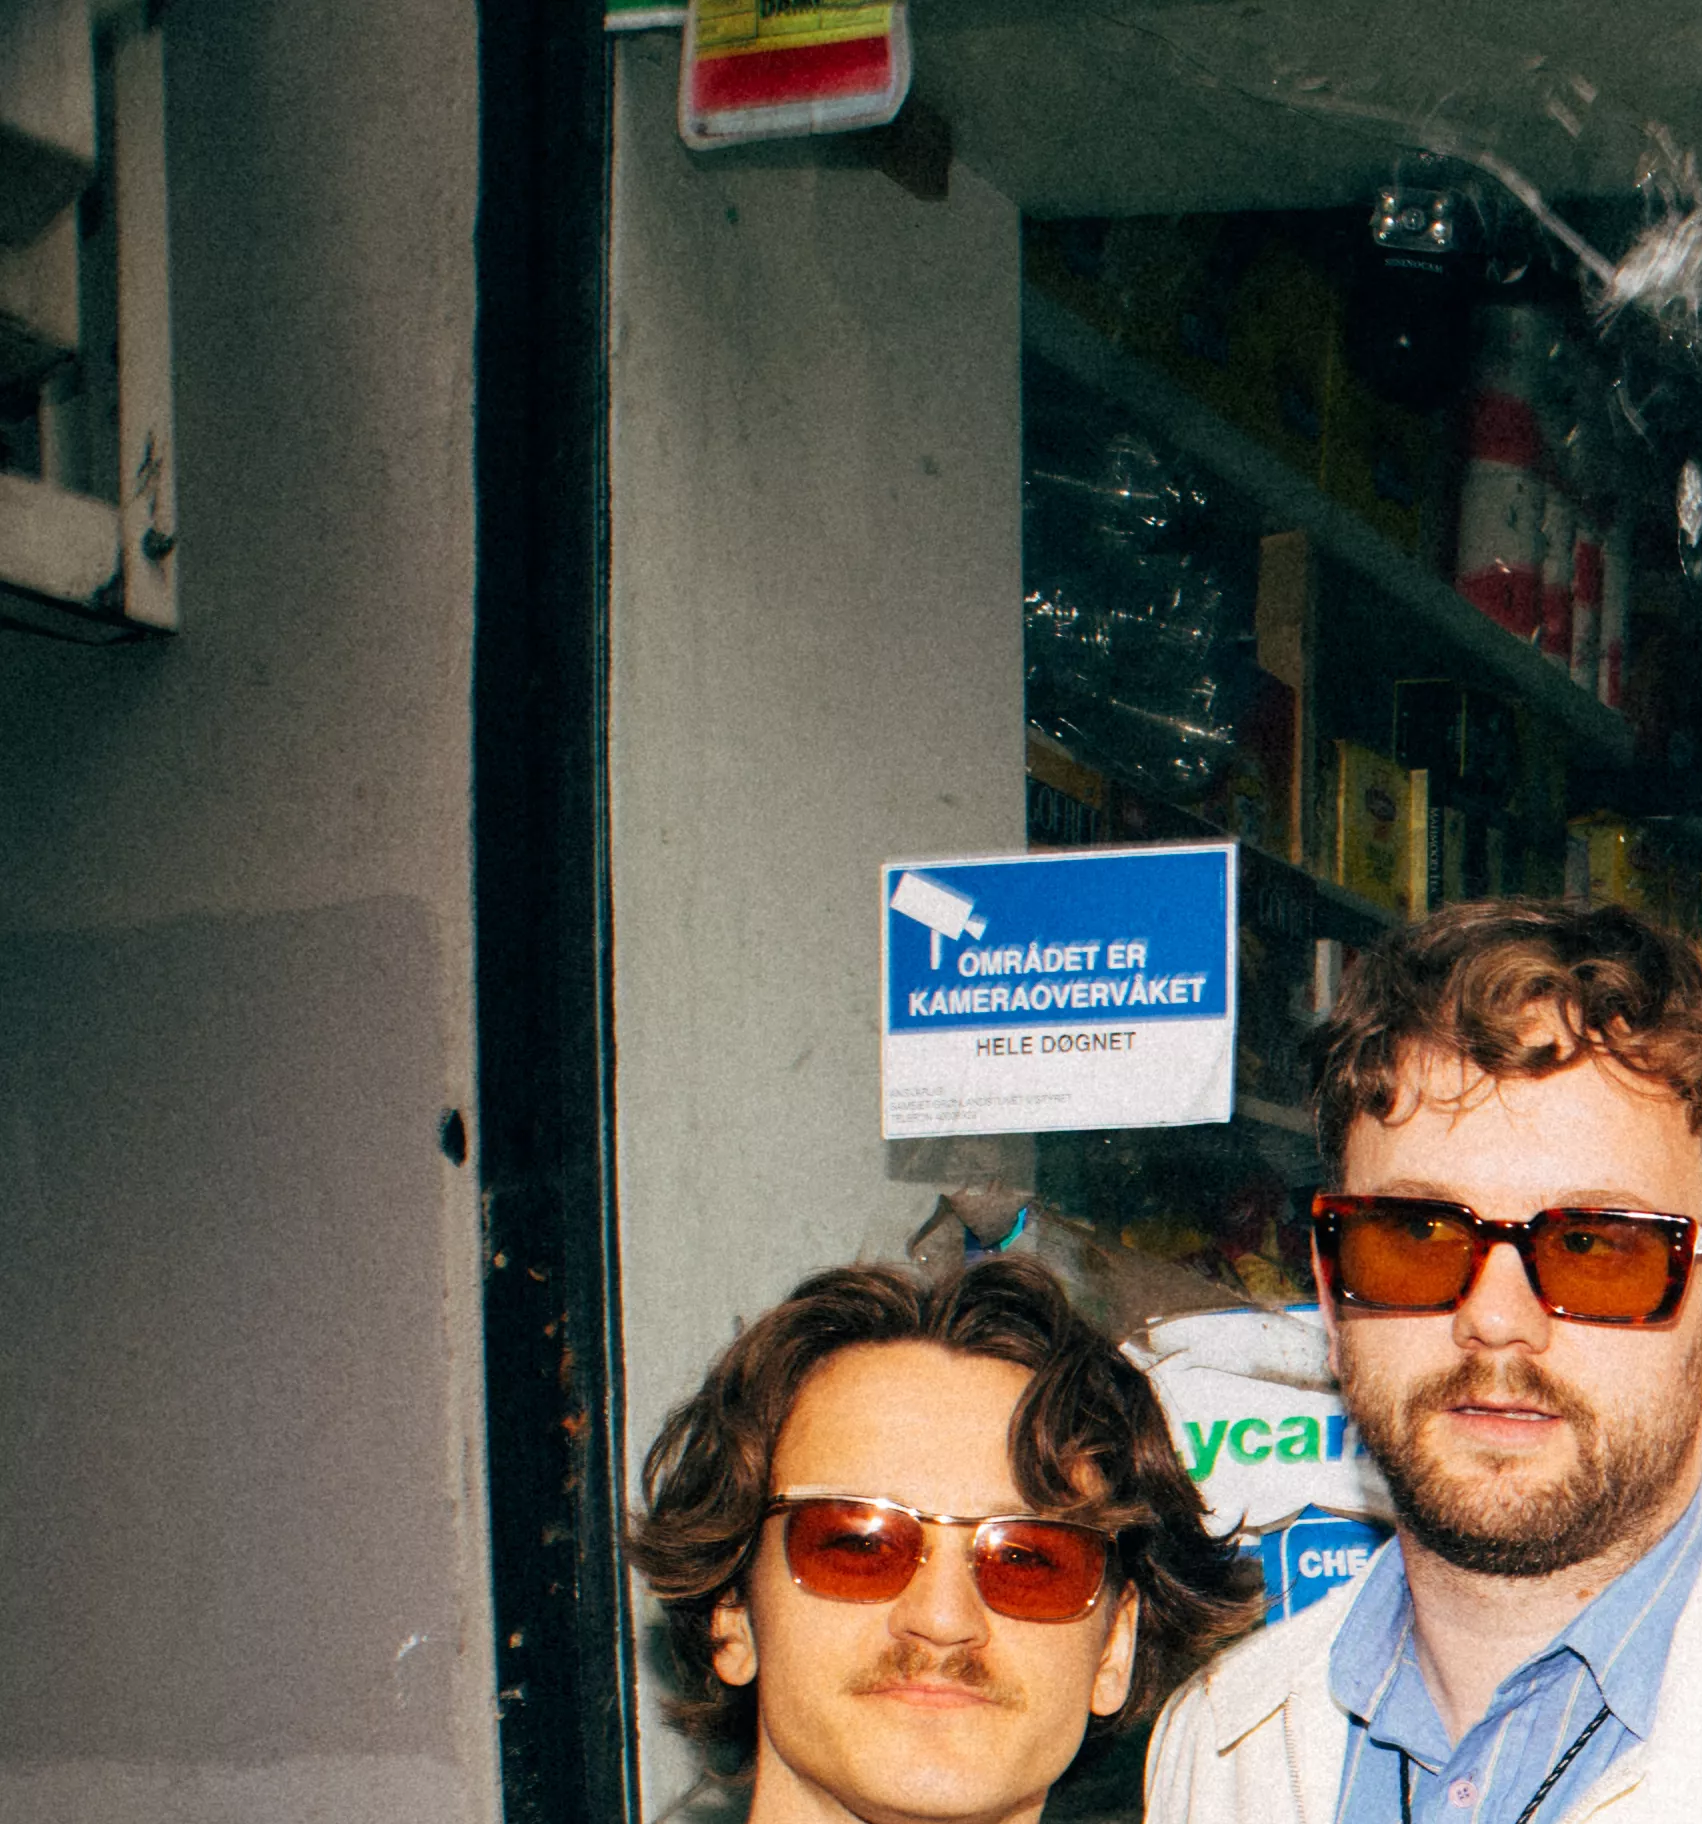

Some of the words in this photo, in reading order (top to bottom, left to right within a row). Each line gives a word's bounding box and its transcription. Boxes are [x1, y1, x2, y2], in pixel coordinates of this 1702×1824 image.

[957, 940, 1101, 977] OMRÅDET
[1107, 943, 1147, 969] ER
[908, 975, 1207, 1017] KAMERAOVERVÅKET
[976, 1037, 1033, 1057] HELE
[1041, 1031, 1137, 1054] DØGNET
[1177, 1415, 1368, 1483] yca
